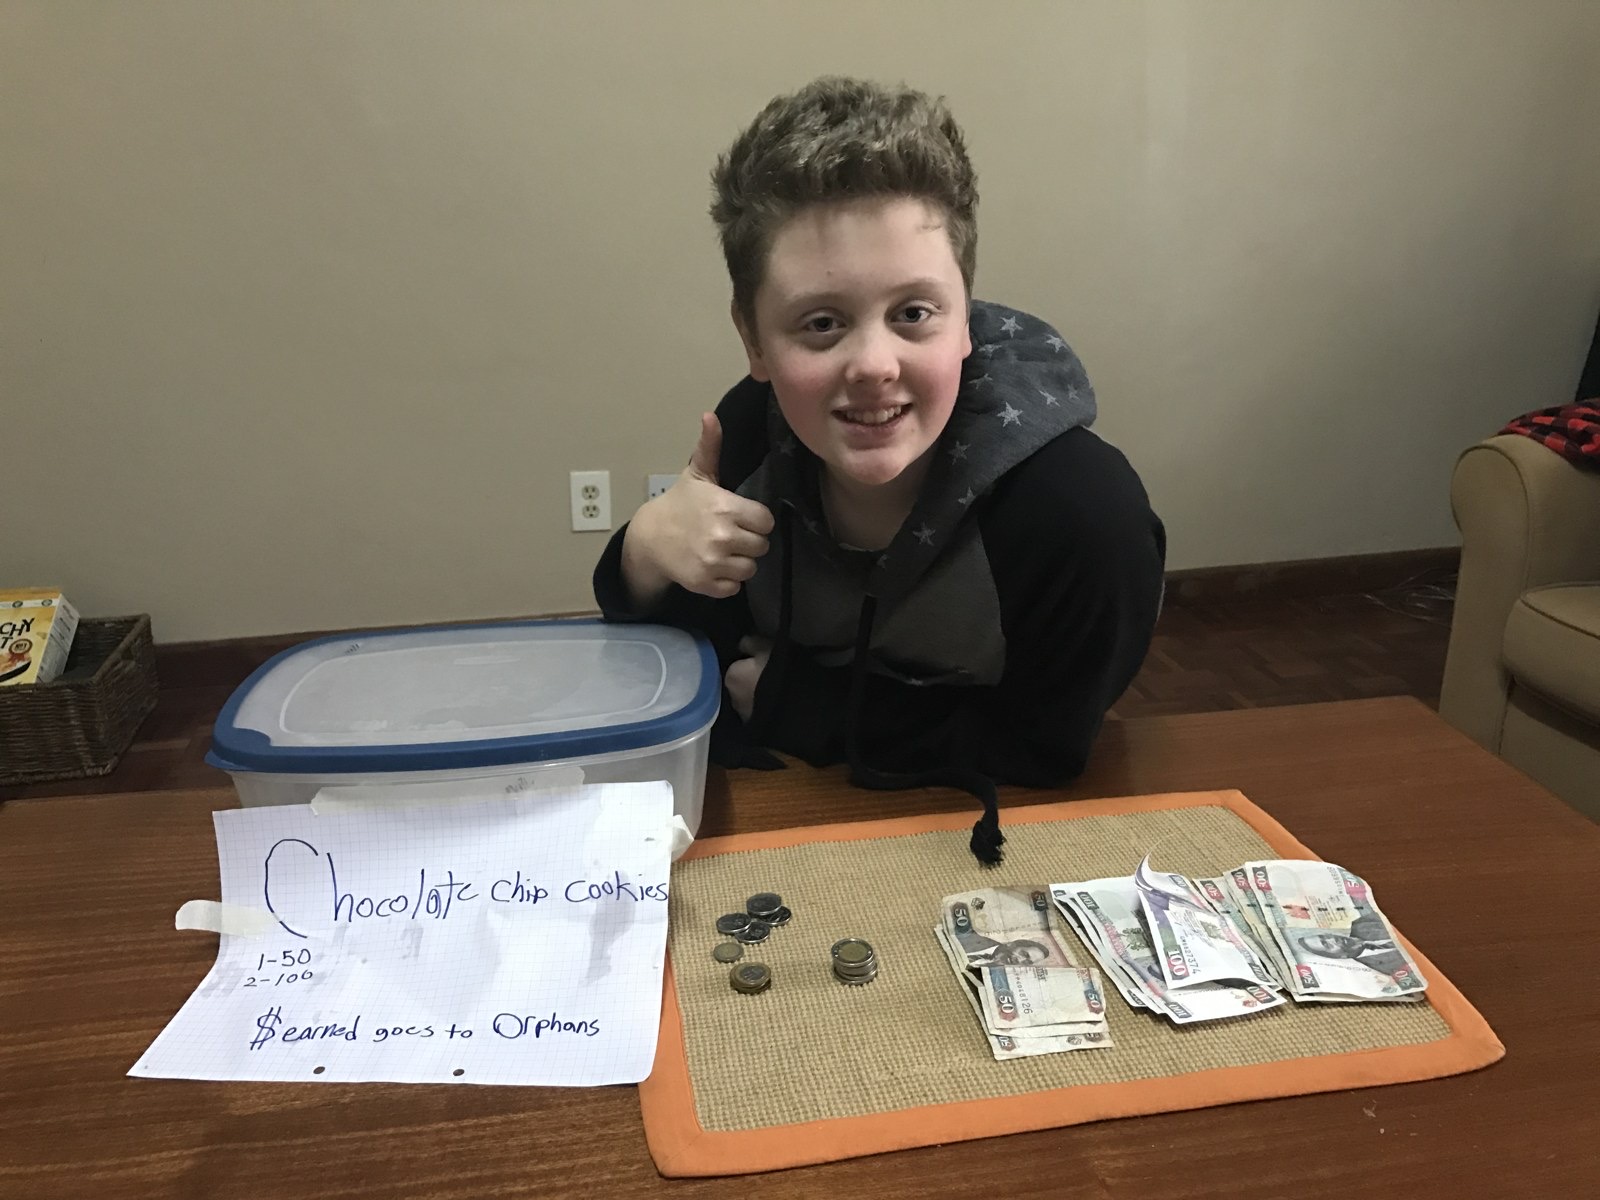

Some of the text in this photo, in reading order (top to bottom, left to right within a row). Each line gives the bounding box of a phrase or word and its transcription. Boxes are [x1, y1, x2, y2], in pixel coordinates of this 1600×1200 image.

[265, 838, 479, 938] Chocolate
[954, 907, 969, 927] 50
[1167, 950, 1187, 977] 100
[999, 994, 1015, 1014] 50
[1087, 992, 1101, 1008] 50
[446, 1023, 473, 1039] to
[493, 1012, 601, 1039] Orphans
